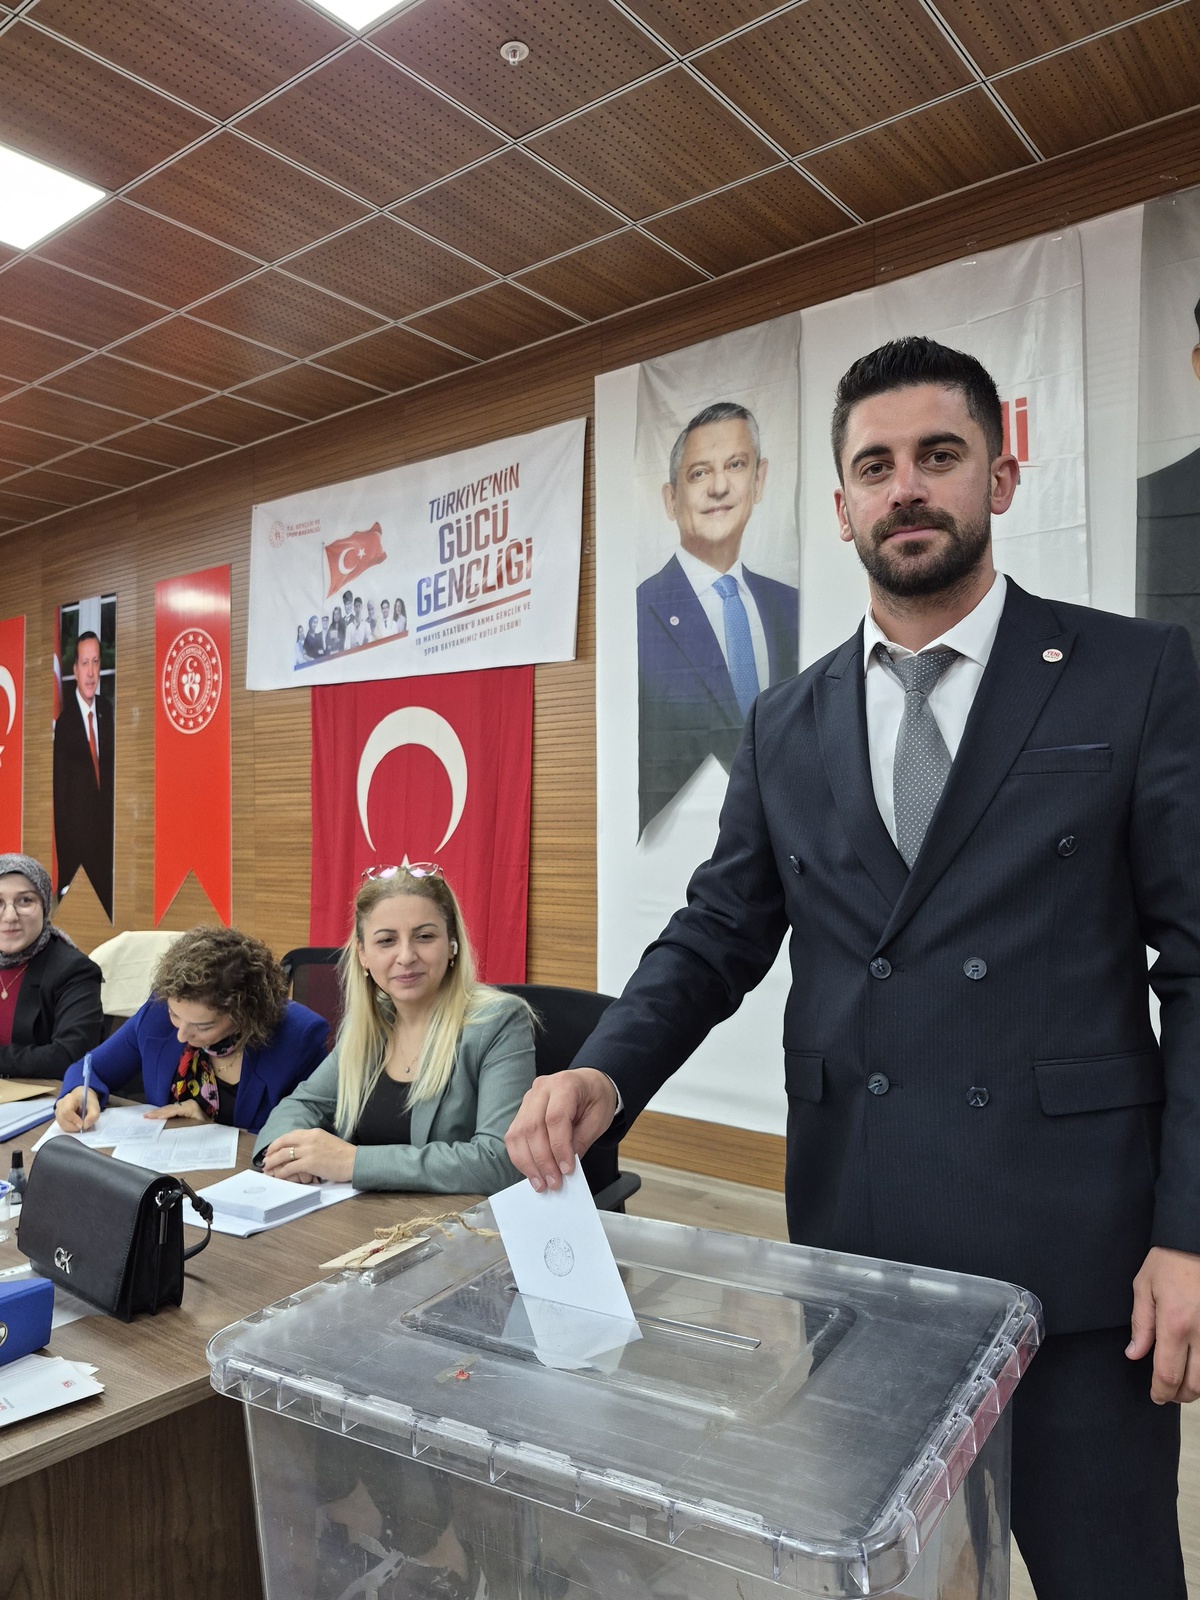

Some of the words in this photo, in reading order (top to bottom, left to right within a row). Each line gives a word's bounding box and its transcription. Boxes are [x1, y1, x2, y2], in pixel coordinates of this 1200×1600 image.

[428, 462, 520, 524] TÜRKİYE'NİN
[438, 499, 509, 565] GÜCÜ
[416, 537, 533, 617] GENÇLİĞİ
[423, 631, 441, 643] MAYIS
[477, 614, 495, 626] ANMA
[495, 605, 522, 621] GENÇLİK
[523, 601, 531, 612] VE
[424, 645, 439, 657] SPOR
[479, 626, 498, 639] KUTLU
